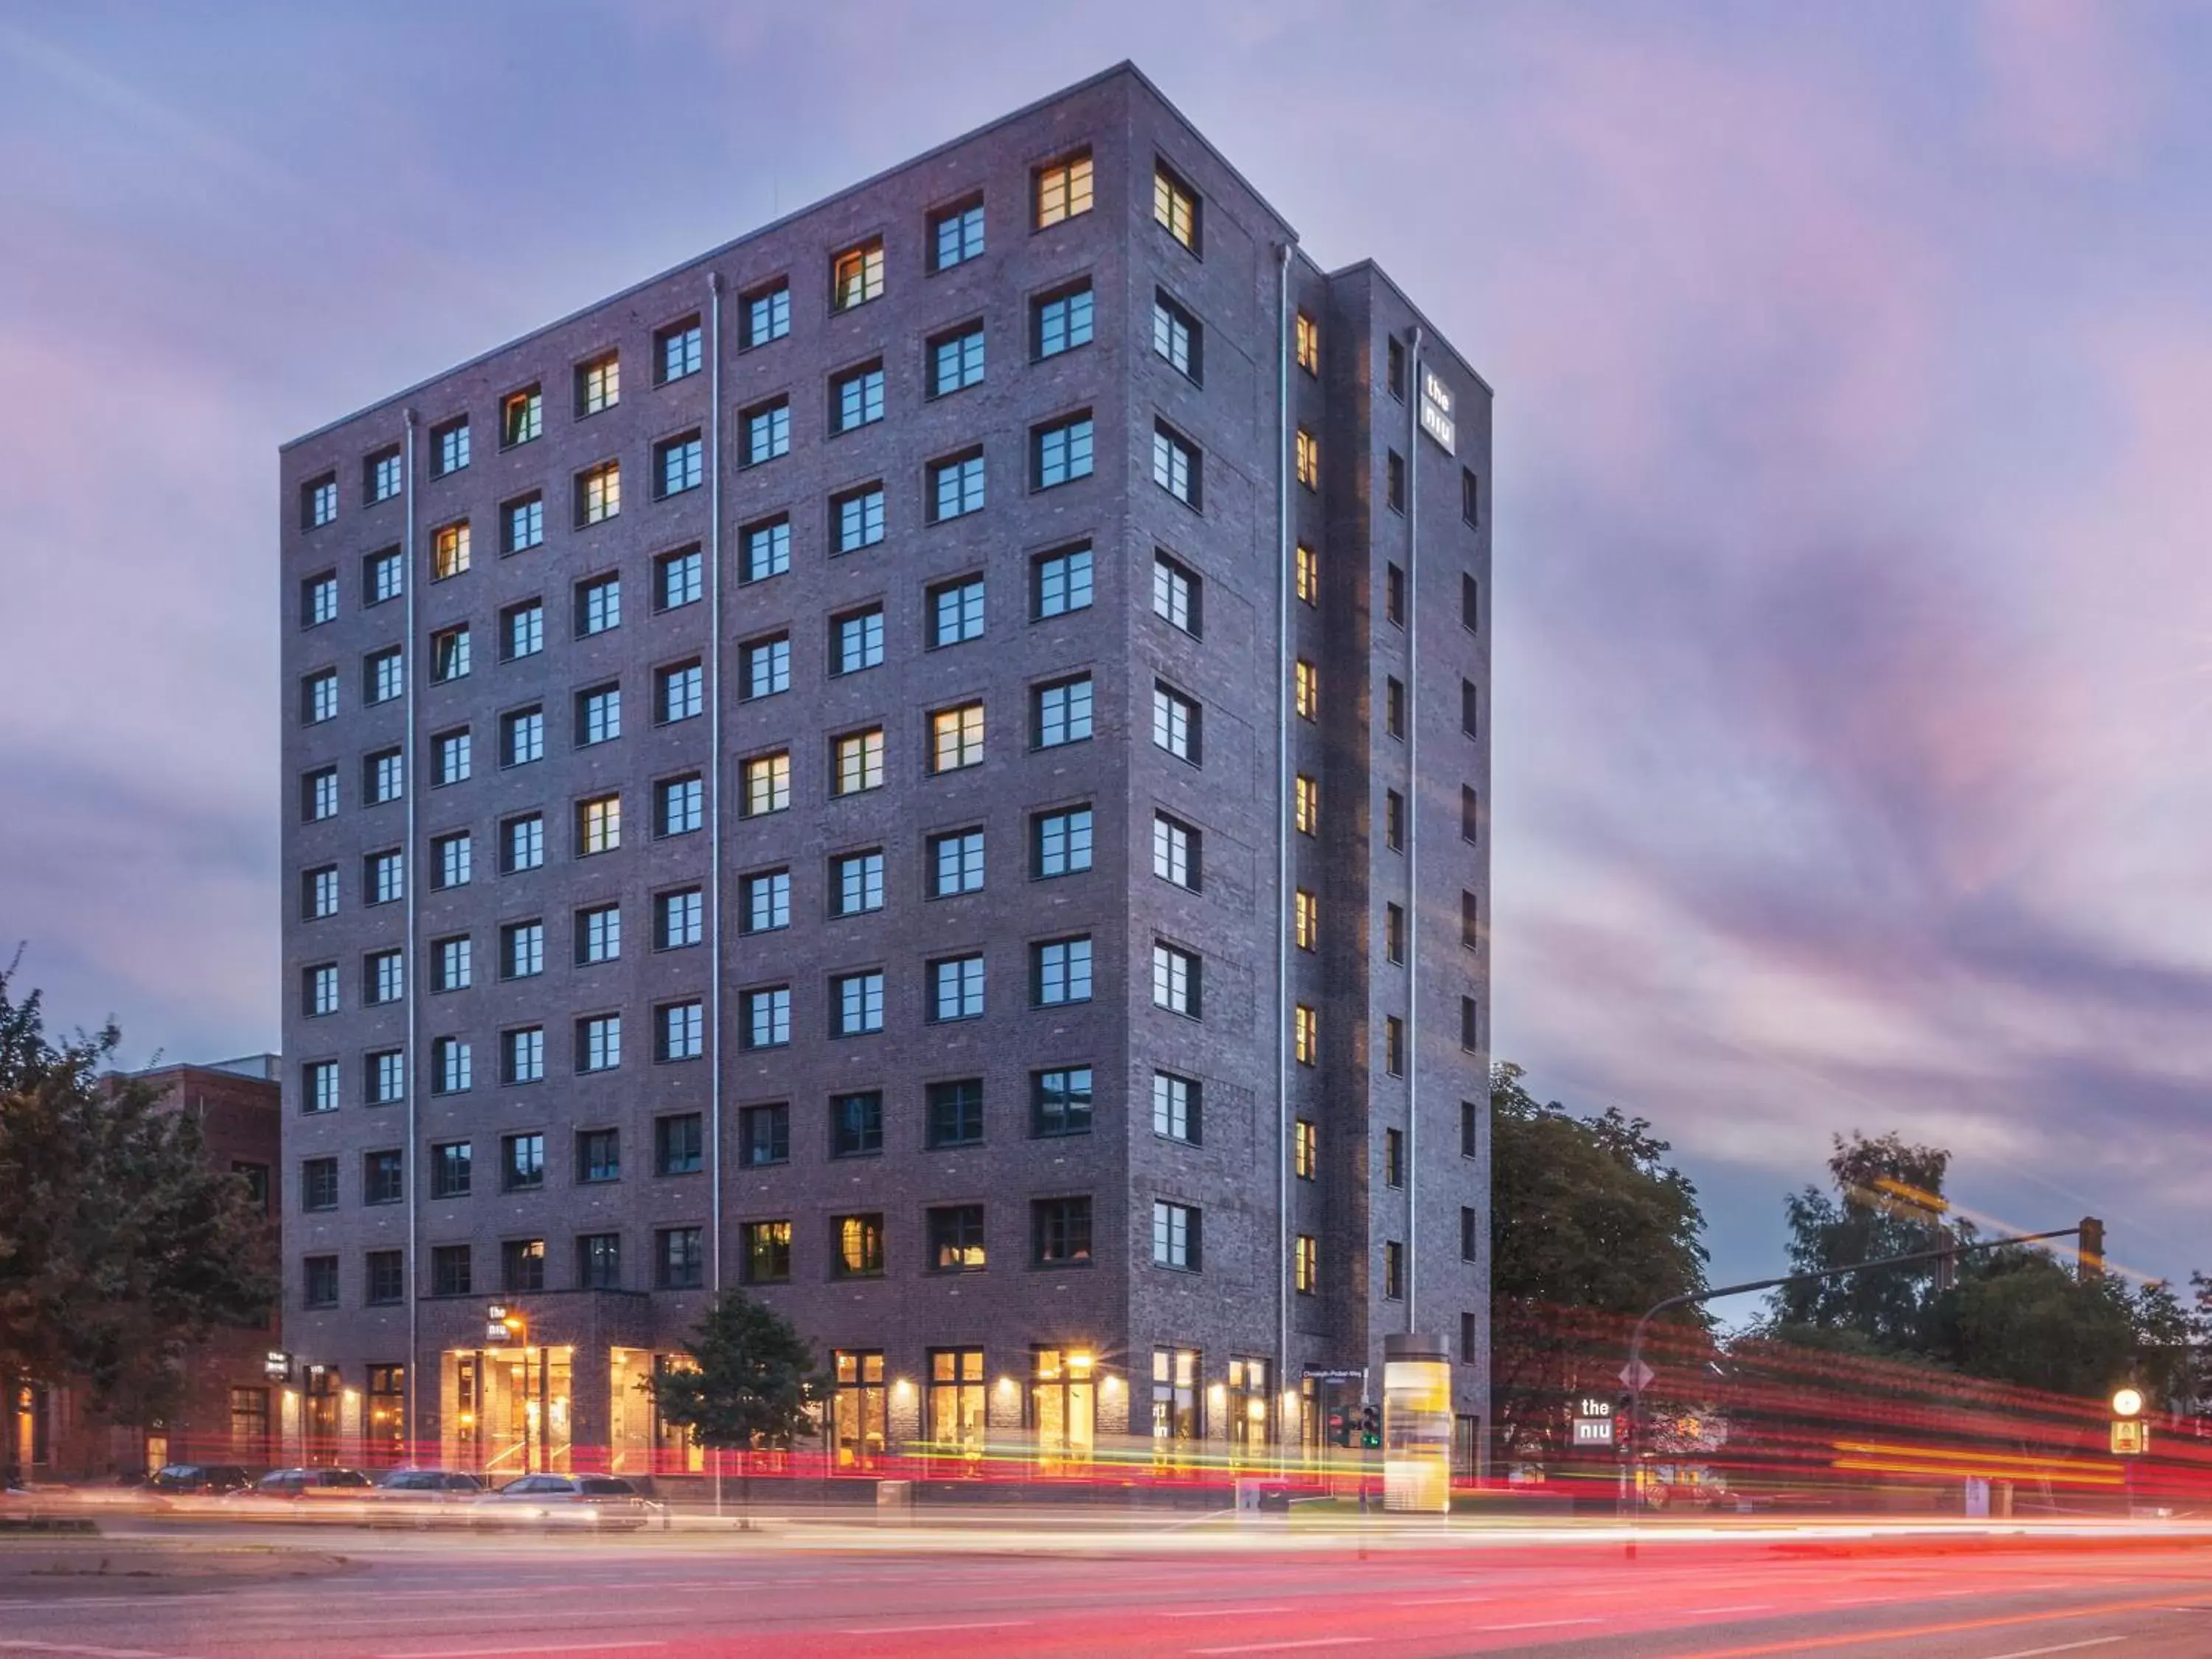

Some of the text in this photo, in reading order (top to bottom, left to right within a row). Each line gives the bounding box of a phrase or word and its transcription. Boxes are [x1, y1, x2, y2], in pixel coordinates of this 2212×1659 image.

[1427, 375, 1450, 412] the
[1427, 406, 1450, 442] niu
[1582, 1399, 1610, 1416] the
[1581, 1425, 1610, 1439] niu
